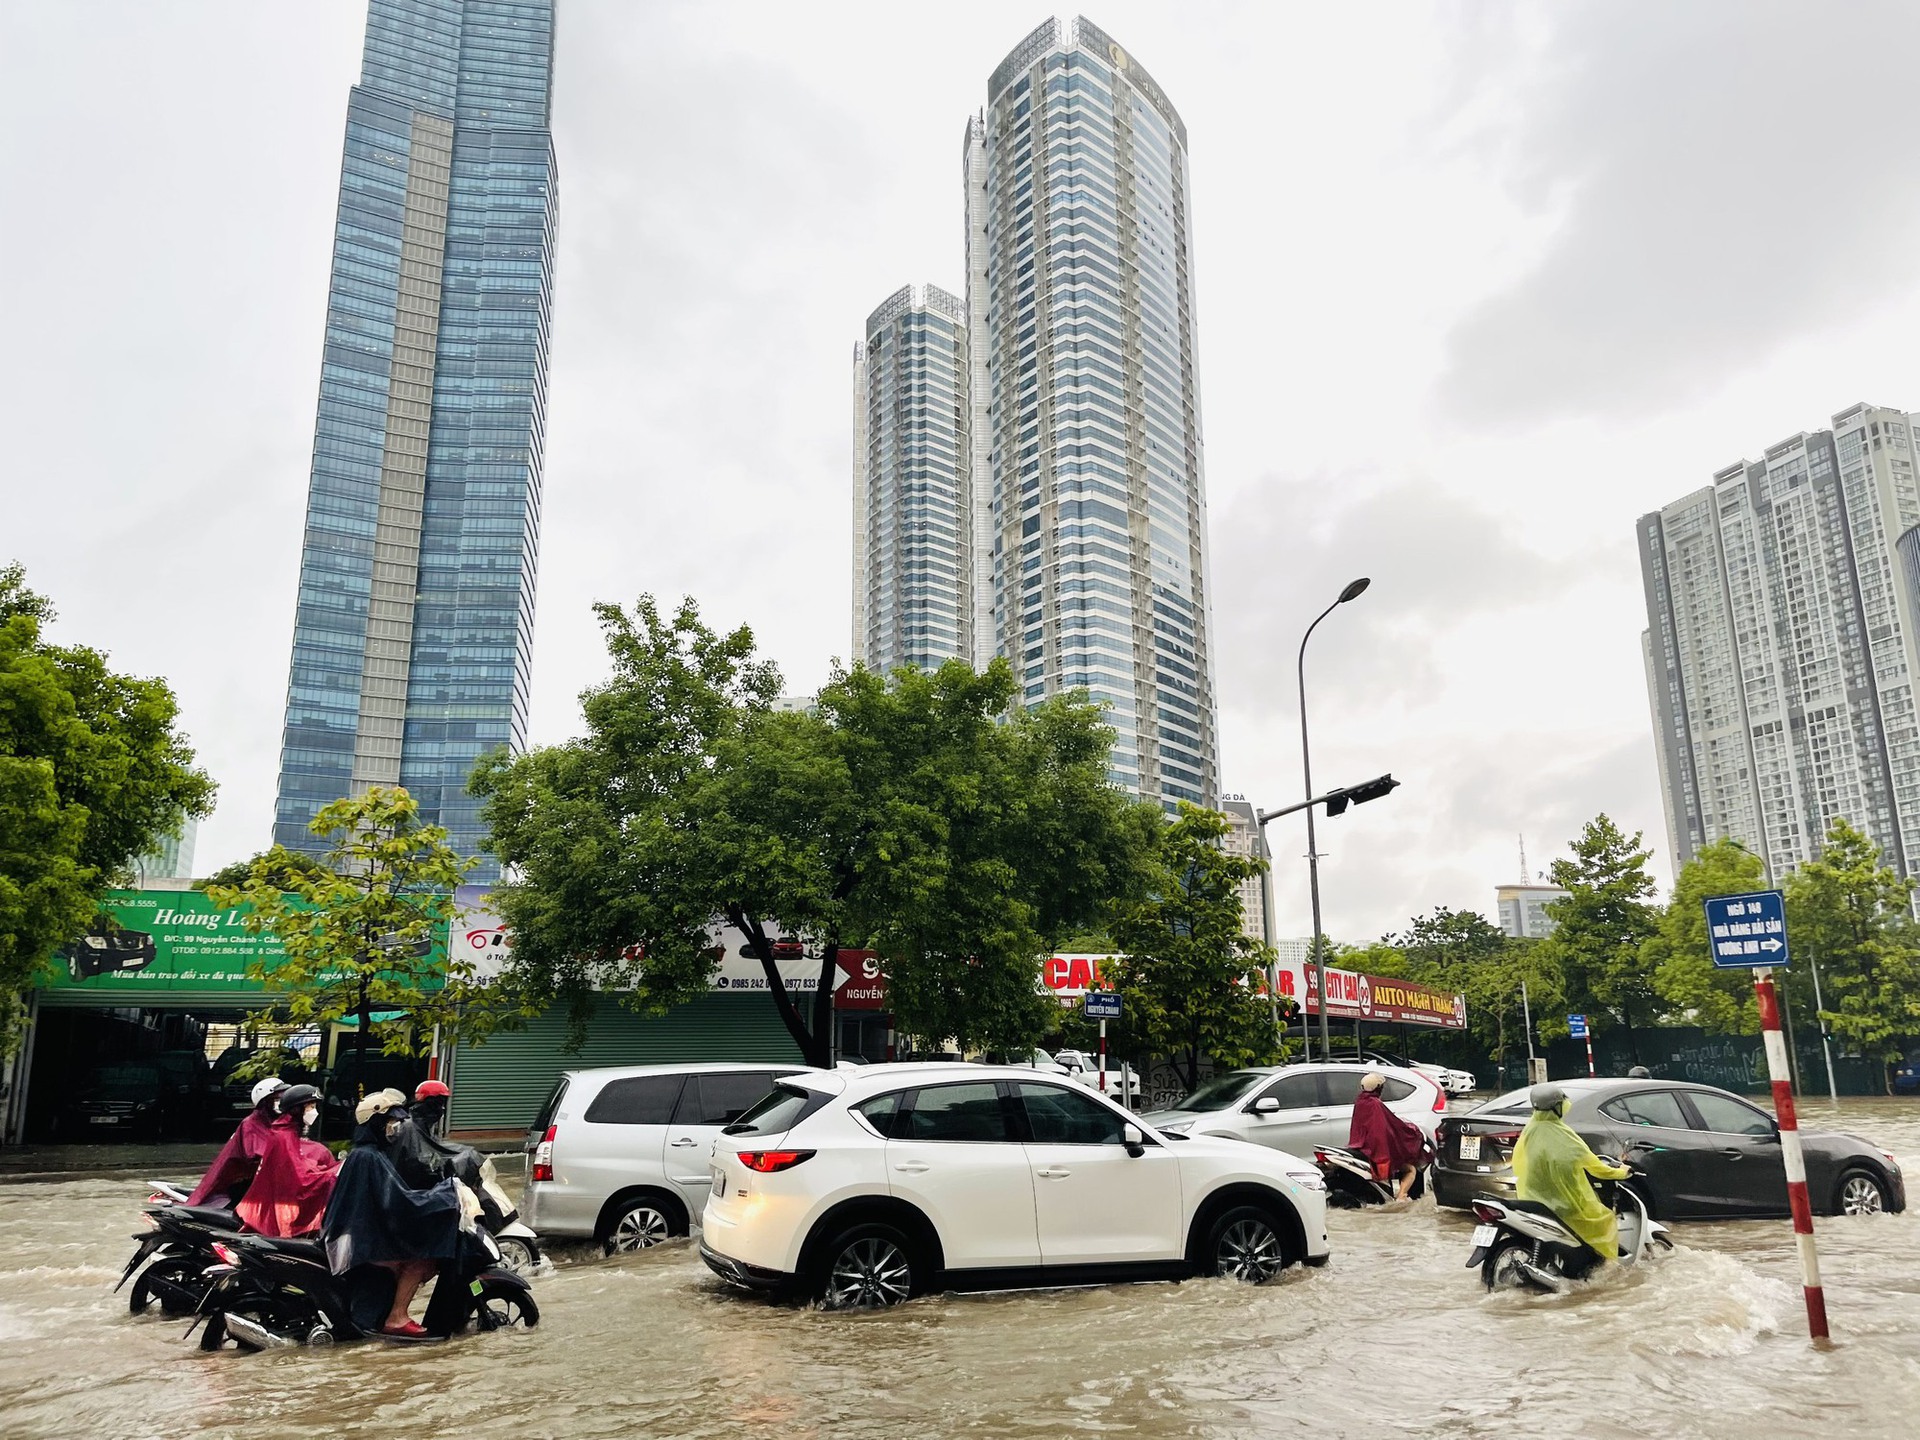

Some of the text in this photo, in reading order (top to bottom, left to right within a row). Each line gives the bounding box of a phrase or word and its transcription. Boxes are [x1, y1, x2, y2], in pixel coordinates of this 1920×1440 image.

[153, 908, 222, 930] Hoàng
[111, 969, 134, 979] Mua
[158, 971, 178, 979] trao
[227, 973, 245, 981] qua
[731, 978, 749, 988] 0985
[751, 978, 764, 988] 242
[785, 978, 801, 988] 0977
[803, 978, 816, 988] 833
[1325, 971, 1358, 1001] CITY CAR
[1374, 986, 1405, 1006] AUTO
[1406, 990, 1431, 1012] MẠNH
